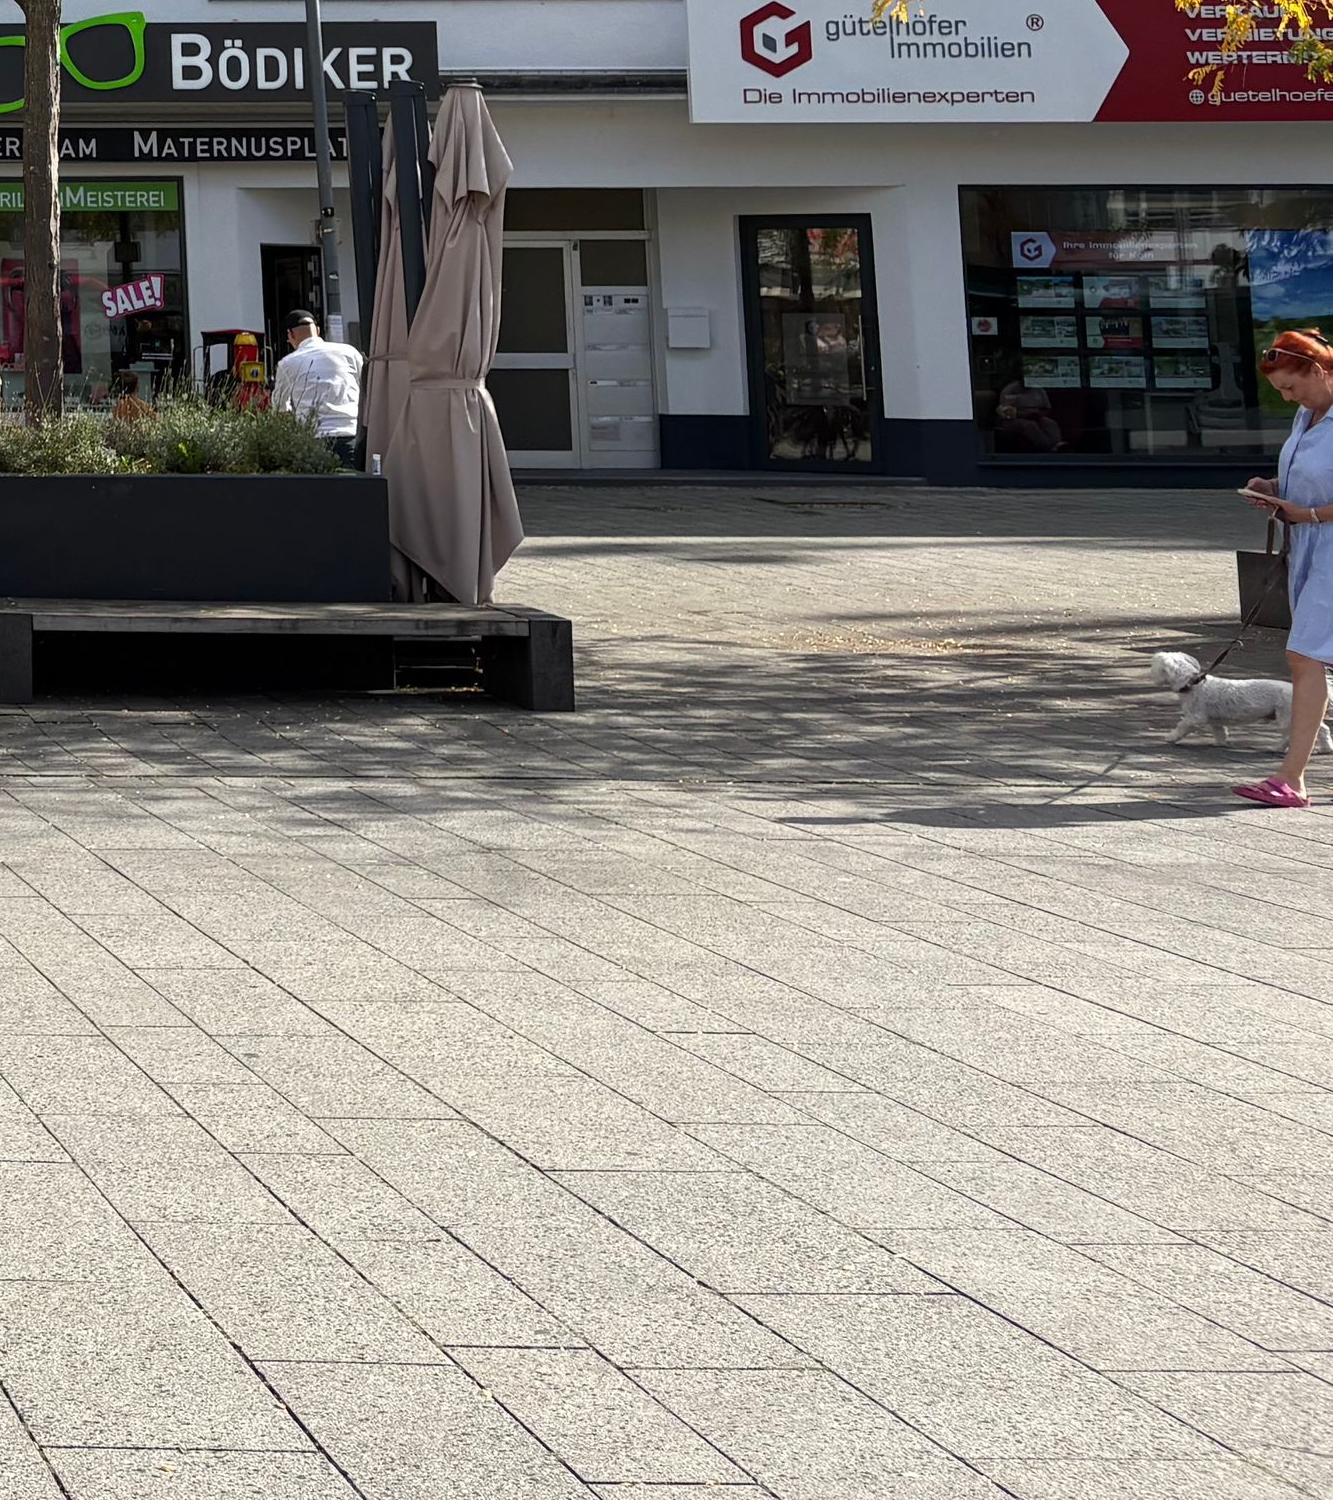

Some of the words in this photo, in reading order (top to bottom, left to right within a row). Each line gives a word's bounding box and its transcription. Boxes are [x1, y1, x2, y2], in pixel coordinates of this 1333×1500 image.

[890, 36, 1032, 58] Immobilien
[170, 33, 414, 90] BÖDIKER
[743, 88, 783, 104] Die
[792, 88, 1035, 105] Immobilienexperten
[60, 137, 97, 158] AM
[132, 130, 349, 158] MATERNUSPLAT
[101, 276, 162, 318] SALE!
